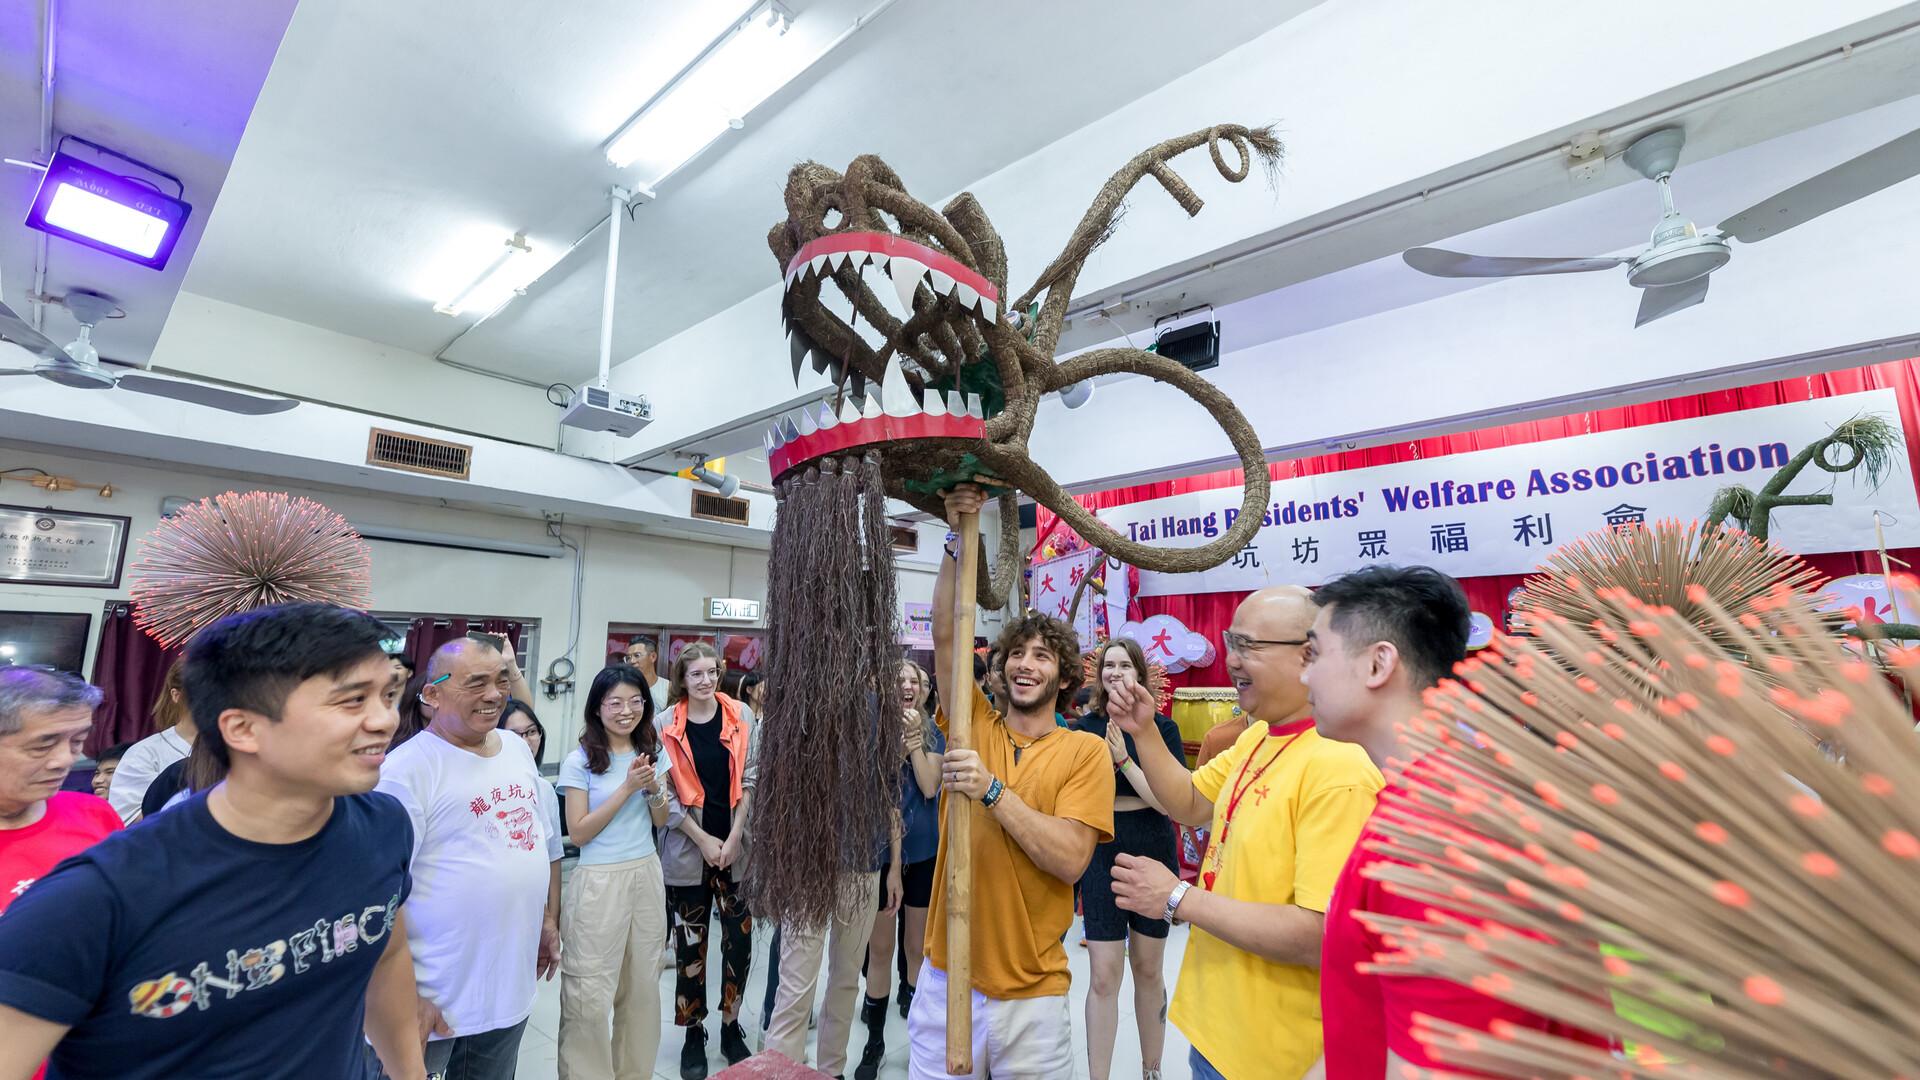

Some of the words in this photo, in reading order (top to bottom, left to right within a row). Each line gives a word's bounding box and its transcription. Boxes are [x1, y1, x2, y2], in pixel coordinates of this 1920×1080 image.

[1127, 518, 1157, 542] Tai
[1161, 511, 1219, 538] Hang
[1224, 491, 1365, 531] Rsidents'
[1381, 479, 1516, 513] Welfare
[1526, 442, 1790, 498] Association
[1151, 628, 1176, 656] 大
